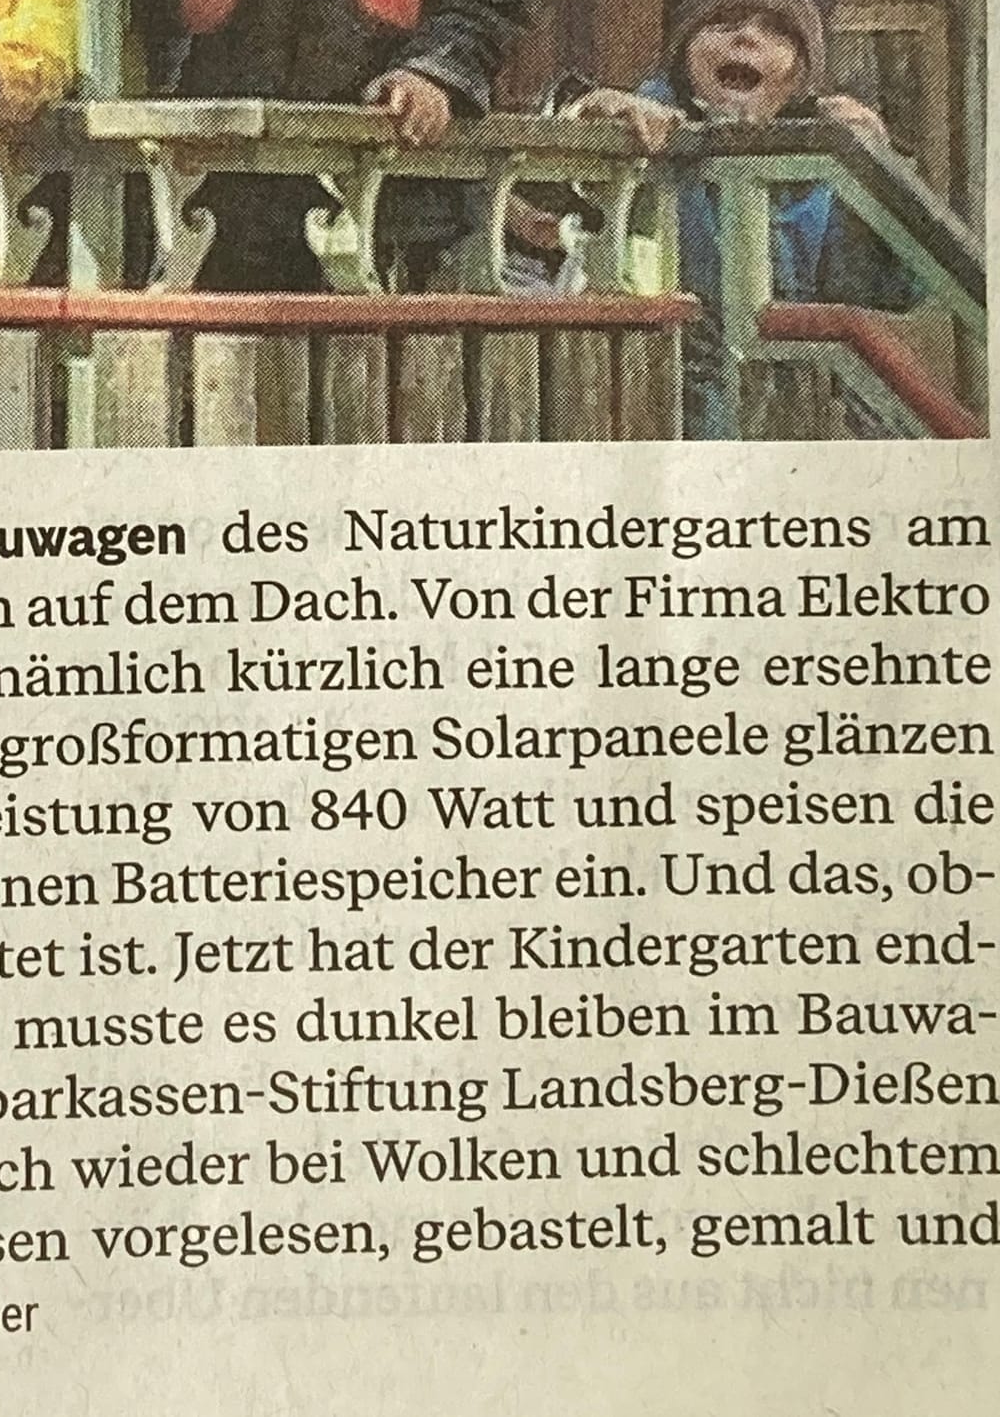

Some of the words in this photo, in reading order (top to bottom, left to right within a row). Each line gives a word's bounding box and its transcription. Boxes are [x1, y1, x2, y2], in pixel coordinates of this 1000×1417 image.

[221, 508, 309, 554] des
[343, 503, 872, 560] Naturkindergartens
[907, 515, 992, 548] am
[27, 579, 115, 628] auf
[124, 579, 240, 626] dem
[250, 575, 398, 623] Dach.
[409, 577, 516, 620] Von
[527, 574, 613, 619] der
[623, 573, 787, 619] Firma
[797, 571, 990, 618] Elektro
[227, 644, 445, 693] kürzlich
[467, 644, 575, 691] eine
[597, 643, 740, 699] lange
[763, 640, 992, 687] ersehnte
[431, 710, 769, 770] Solarpaneele
[783, 710, 995, 767] glänzen
[191, 799, 291, 833] von
[310, 787, 407, 831] 840
[426, 786, 556, 830] Watt
[573, 780, 677, 829] und
[695, 780, 895, 837] speisen
[914, 779, 995, 825] die
[111, 854, 543, 912] Batteriespeicher
[555, 853, 647, 899] ein.
[659, 849, 776, 896] Und
[788, 849, 893, 903] das,
[907, 849, 996, 895] ob-
[79, 931, 157, 977] ist.
[173, 931, 294, 984] Jetzt
[307, 926, 395, 973] hat
[408, 925, 495, 971] der
[508, 921, 862, 978] Kindergarten
[875, 919, 996, 965] end-
[13, 1006, 204, 1050] musste
[223, 1011, 277, 1044] es
[296, 995, 479, 1043] dunkel
[494, 992, 691, 1041] bleiben
[708, 991, 780, 1036] im
[797, 992, 997, 1036] Bauwa-
[502, 1060, 1000, 1118] Landsberg-Dießen
[70, 1139, 251, 1189] wieder
[265, 1139, 347, 1185] bei
[361, 1135, 562, 1183] Wolken
[575, 1131, 681, 1179] und
[697, 1129, 1000, 1177] schlechtem
[90, 1210, 390, 1269] vorgelesen,
[412, 1202, 667, 1264] gebastelt,
[690, 1199, 876, 1259] gemalt
[896, 1199, 1000, 1246] und
